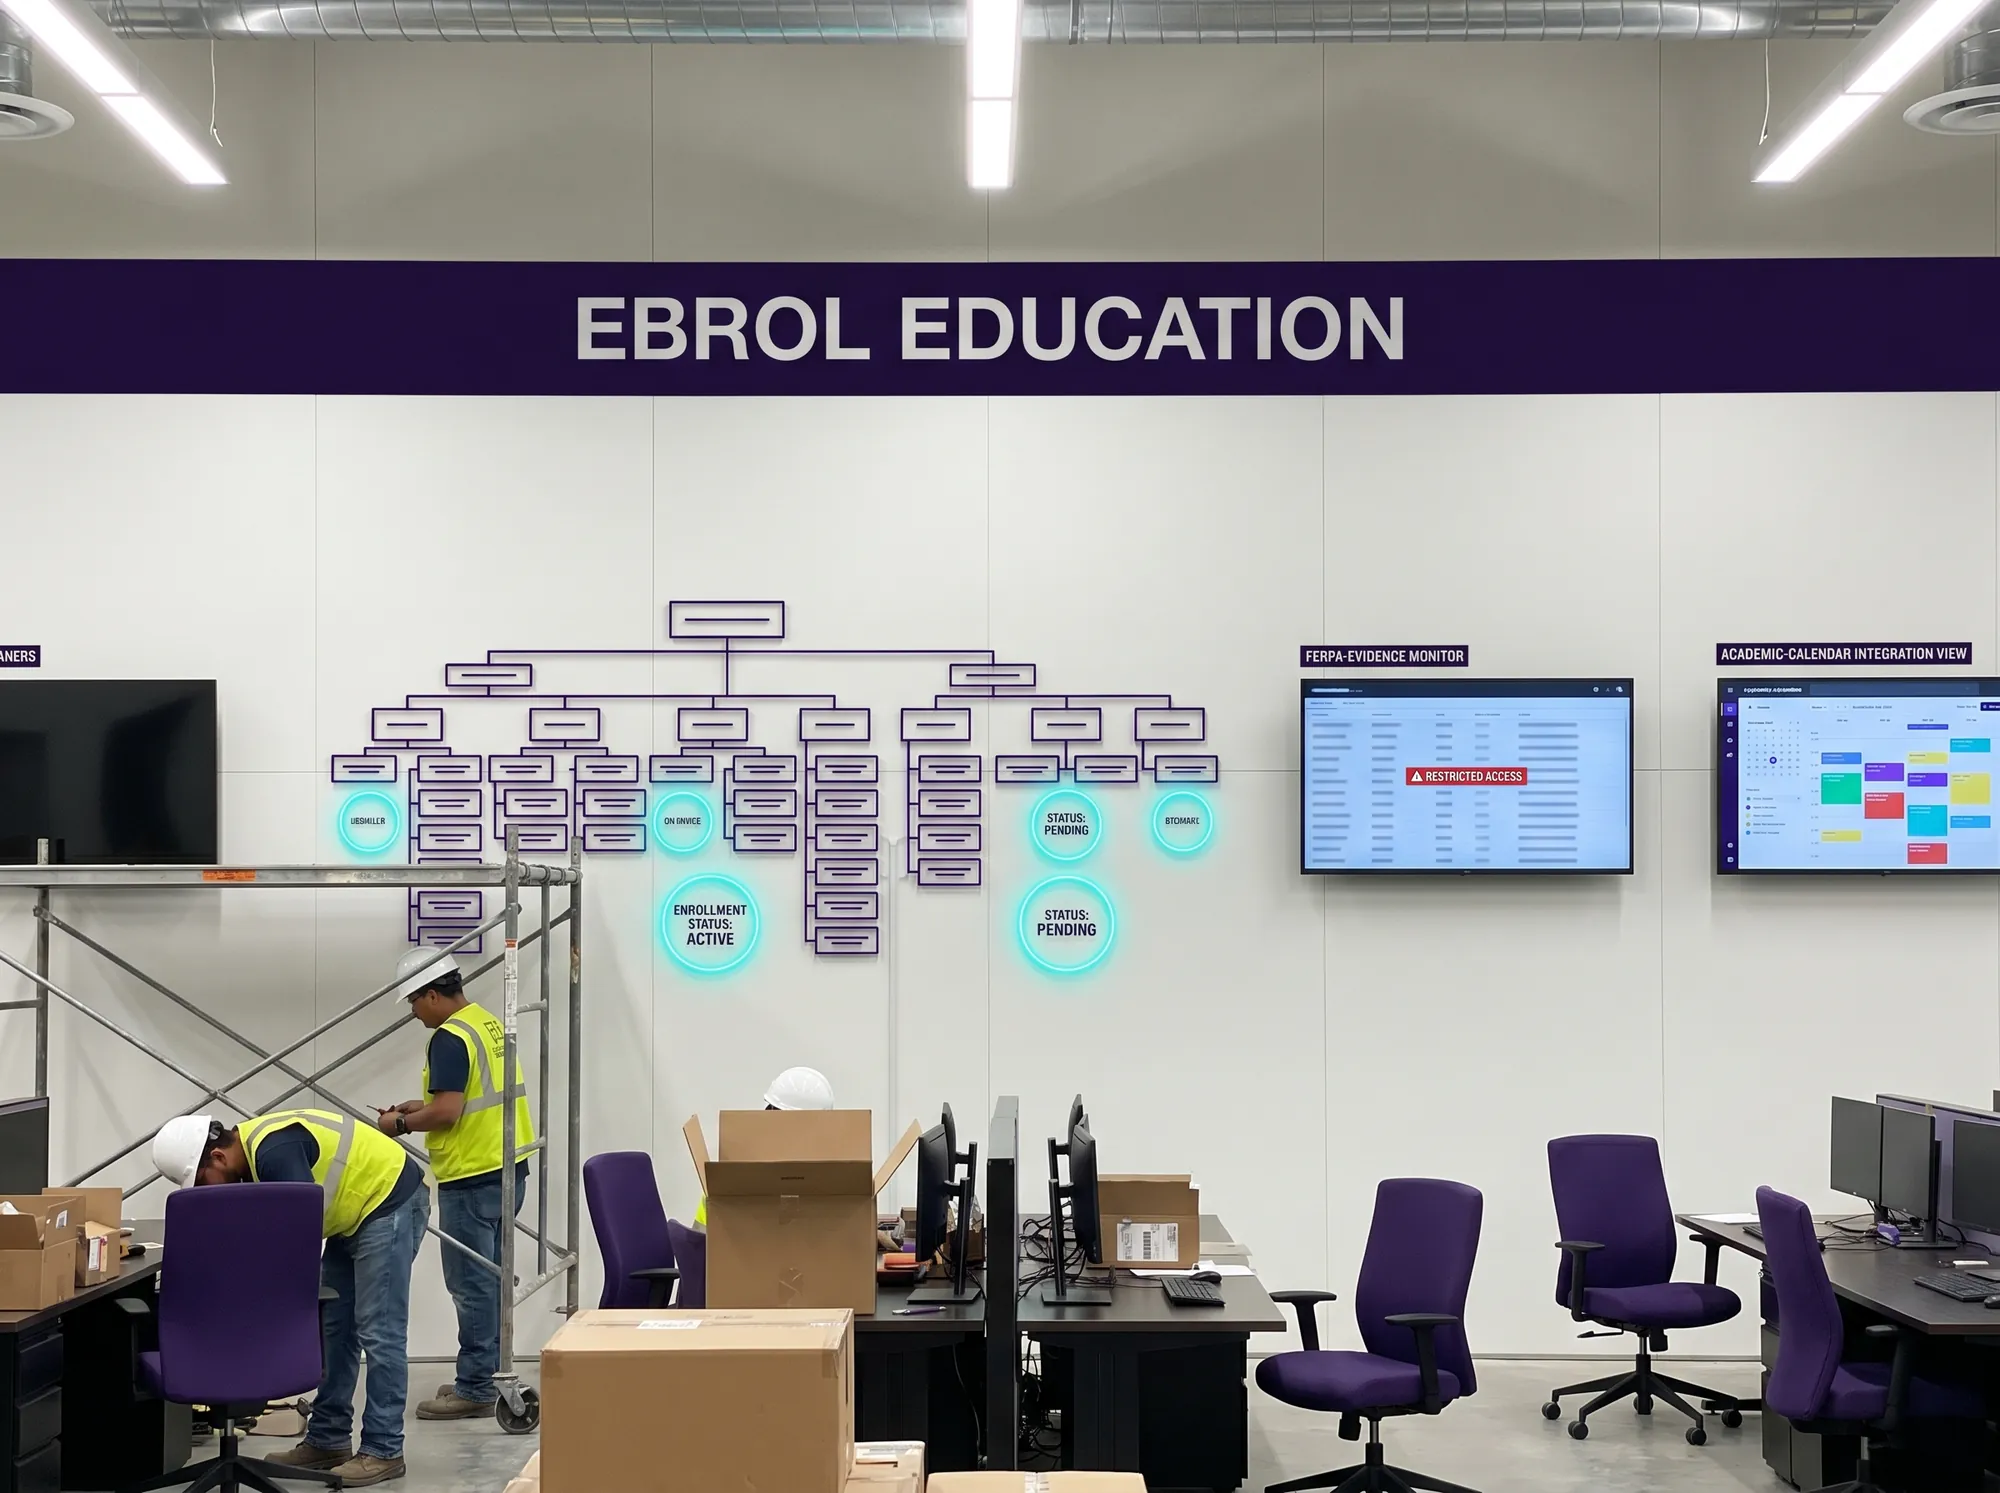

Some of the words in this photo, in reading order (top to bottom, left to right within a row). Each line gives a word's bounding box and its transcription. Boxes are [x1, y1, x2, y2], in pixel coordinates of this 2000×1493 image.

[577, 296, 871, 361] EBROL
[901, 296, 1404, 361] EDUCATION
[1305, 649, 1407, 663] FERPA-EVIDENCE
[1408, 649, 1464, 663] MONITOR
[1721, 647, 1852, 661] ACADEMIC-CALENDAR
[1854, 647, 1934, 661] INTEGRATION
[1936, 647, 1968, 660] VIEW
[1425, 771, 1484, 783] RESTRICTED
[1485, 771, 1523, 783] ACCESS
[664, 817, 675, 825] ON
[1046, 812, 1087, 824] STATUS:
[1044, 824, 1089, 836] PENDING
[673, 904, 747, 916] ENROLLMENT
[1044, 909, 1089, 921] STATUS:
[688, 918, 733, 930] STATUS:
[1037, 923, 1097, 937] PENDING
[686, 932, 734, 946] ACTIVE
